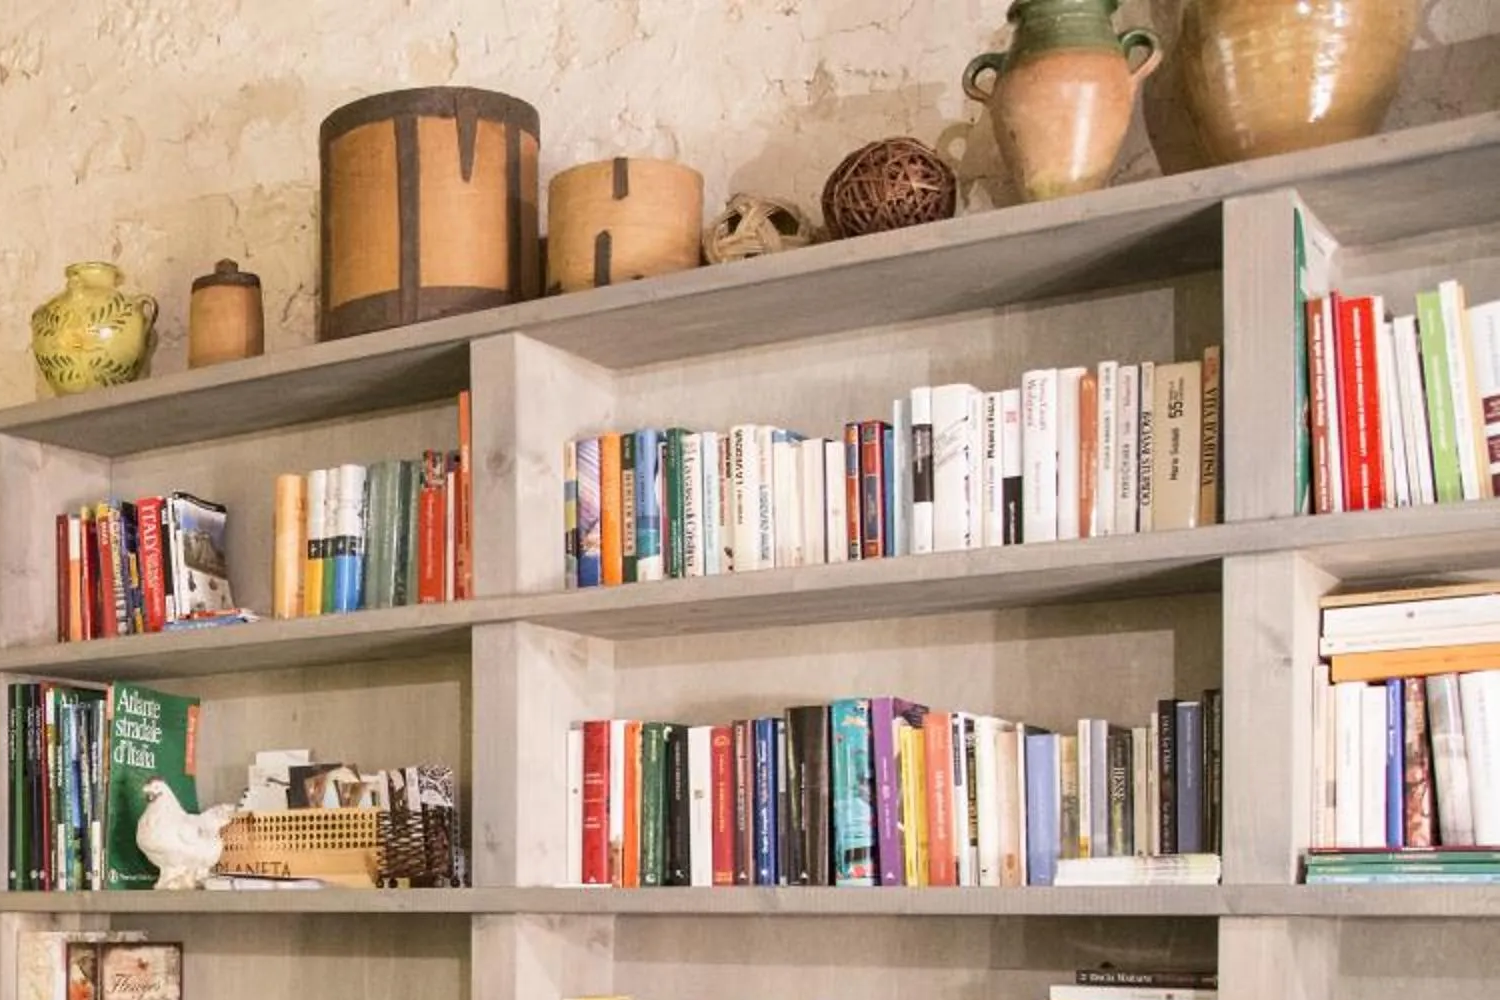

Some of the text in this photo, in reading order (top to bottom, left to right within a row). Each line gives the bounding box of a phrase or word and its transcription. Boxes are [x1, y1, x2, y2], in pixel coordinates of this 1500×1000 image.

[140, 503, 156, 543] ITALY
[118, 687, 161, 718] Atlante
[114, 718, 162, 745] stradale
[113, 741, 155, 770] d'Italia
[1112, 766, 1125, 802] HESSE
